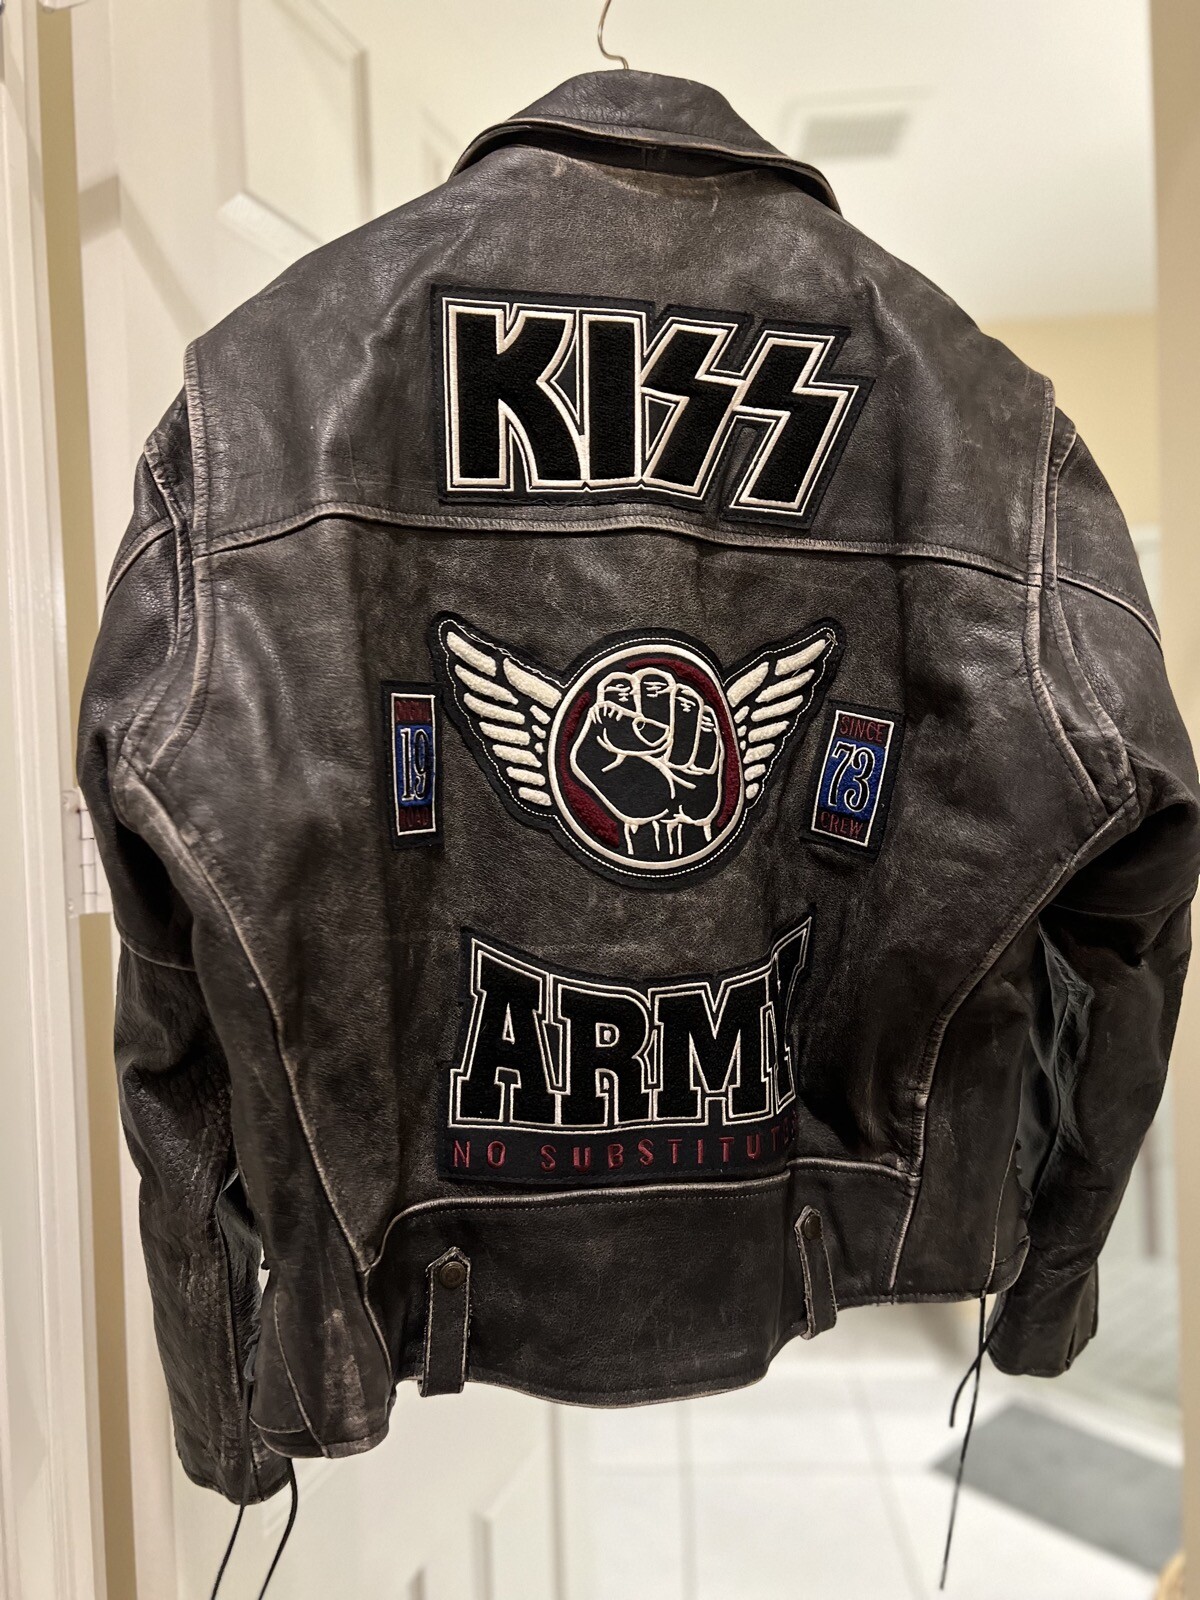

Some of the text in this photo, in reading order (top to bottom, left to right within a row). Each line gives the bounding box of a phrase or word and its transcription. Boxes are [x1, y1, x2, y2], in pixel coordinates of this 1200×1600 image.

[442, 297, 859, 516] KISS
[400, 727, 429, 801] 19
[839, 715, 887, 742] SINCE
[828, 741, 875, 812] 73
[820, 811, 864, 839] CREW
[448, 916, 812, 1135] ARMY
[453, 1139, 508, 1169] NO
